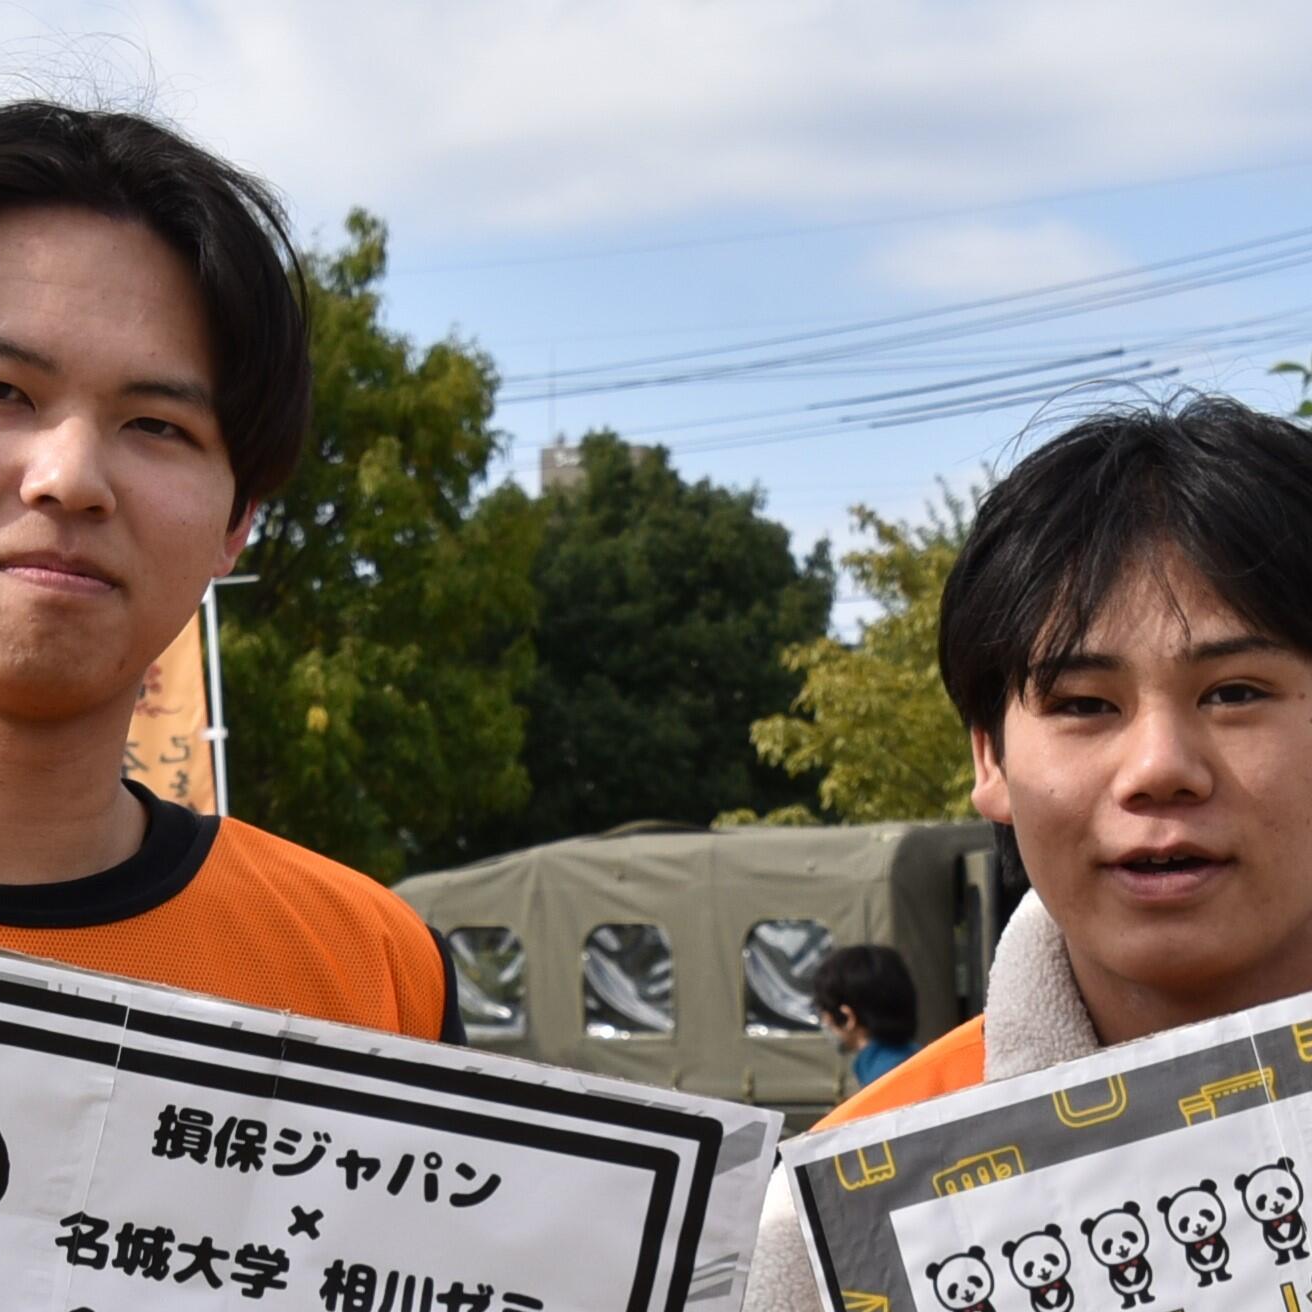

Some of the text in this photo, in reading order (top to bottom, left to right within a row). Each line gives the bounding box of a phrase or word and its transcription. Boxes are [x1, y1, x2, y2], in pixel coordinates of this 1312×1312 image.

[151, 1104, 502, 1208] 損保ジャパン
[54, 1211, 290, 1299] 名城大学
